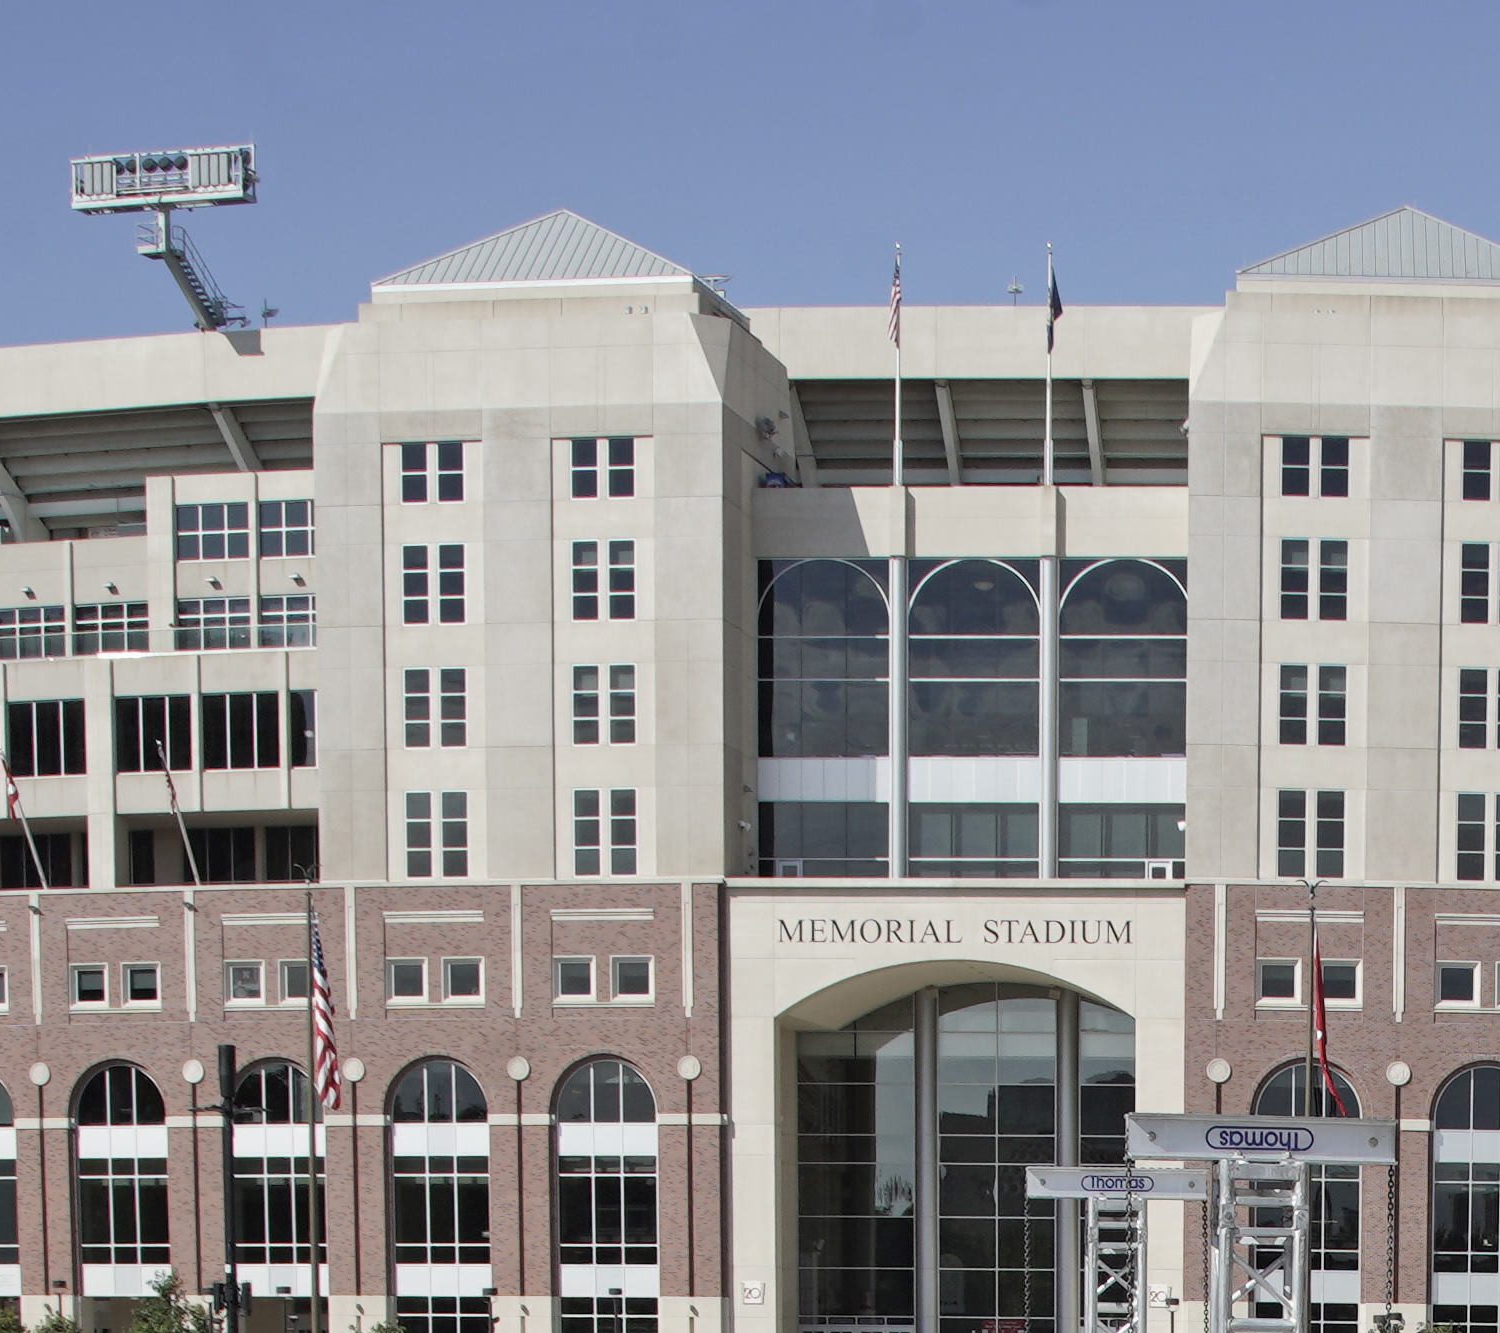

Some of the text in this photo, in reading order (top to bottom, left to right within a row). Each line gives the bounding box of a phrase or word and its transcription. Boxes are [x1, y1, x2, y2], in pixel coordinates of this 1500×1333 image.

[778, 918, 1133, 945] MEMORIAL STADIUM
[1219, 1130, 1299, 1149] Thomas
